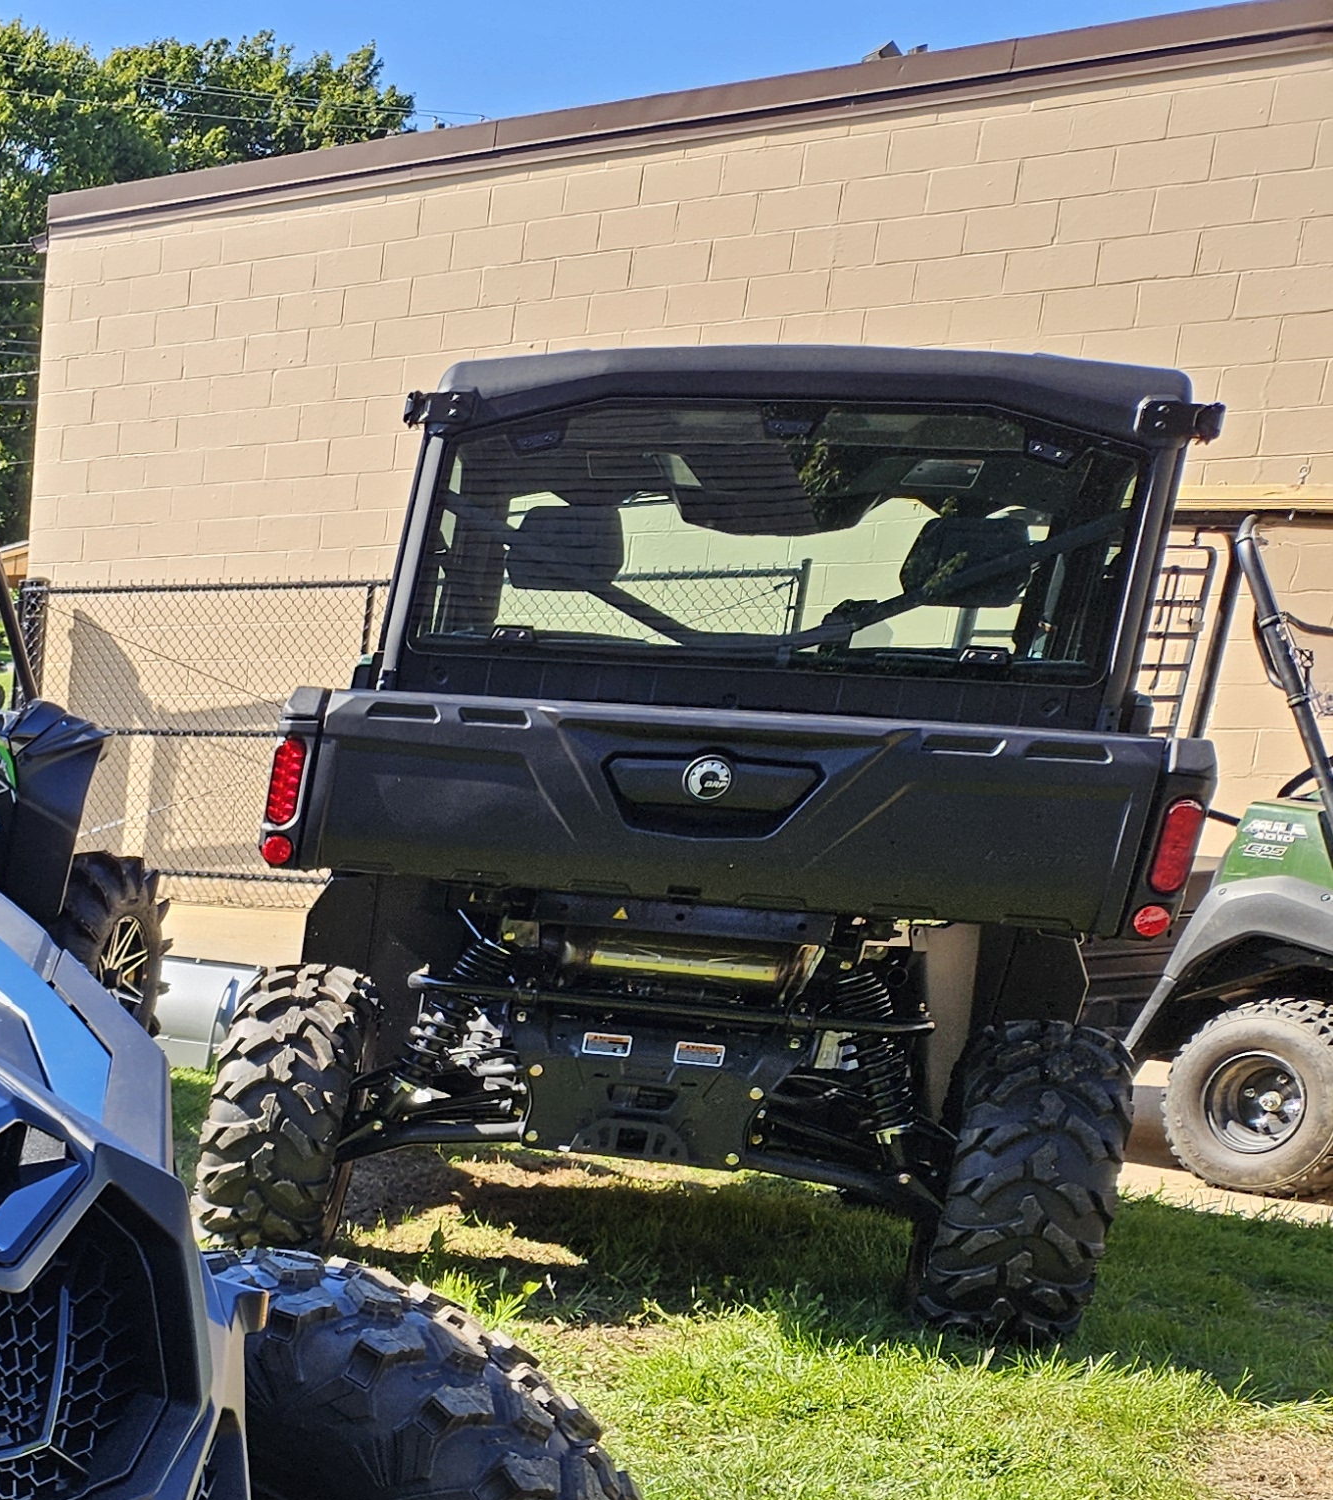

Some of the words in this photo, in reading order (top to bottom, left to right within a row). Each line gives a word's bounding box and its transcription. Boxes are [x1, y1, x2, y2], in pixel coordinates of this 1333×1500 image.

[704, 780, 728, 789] BRP
[1242, 819, 1308, 838] MULE
[1253, 832, 1295, 843] 4010
